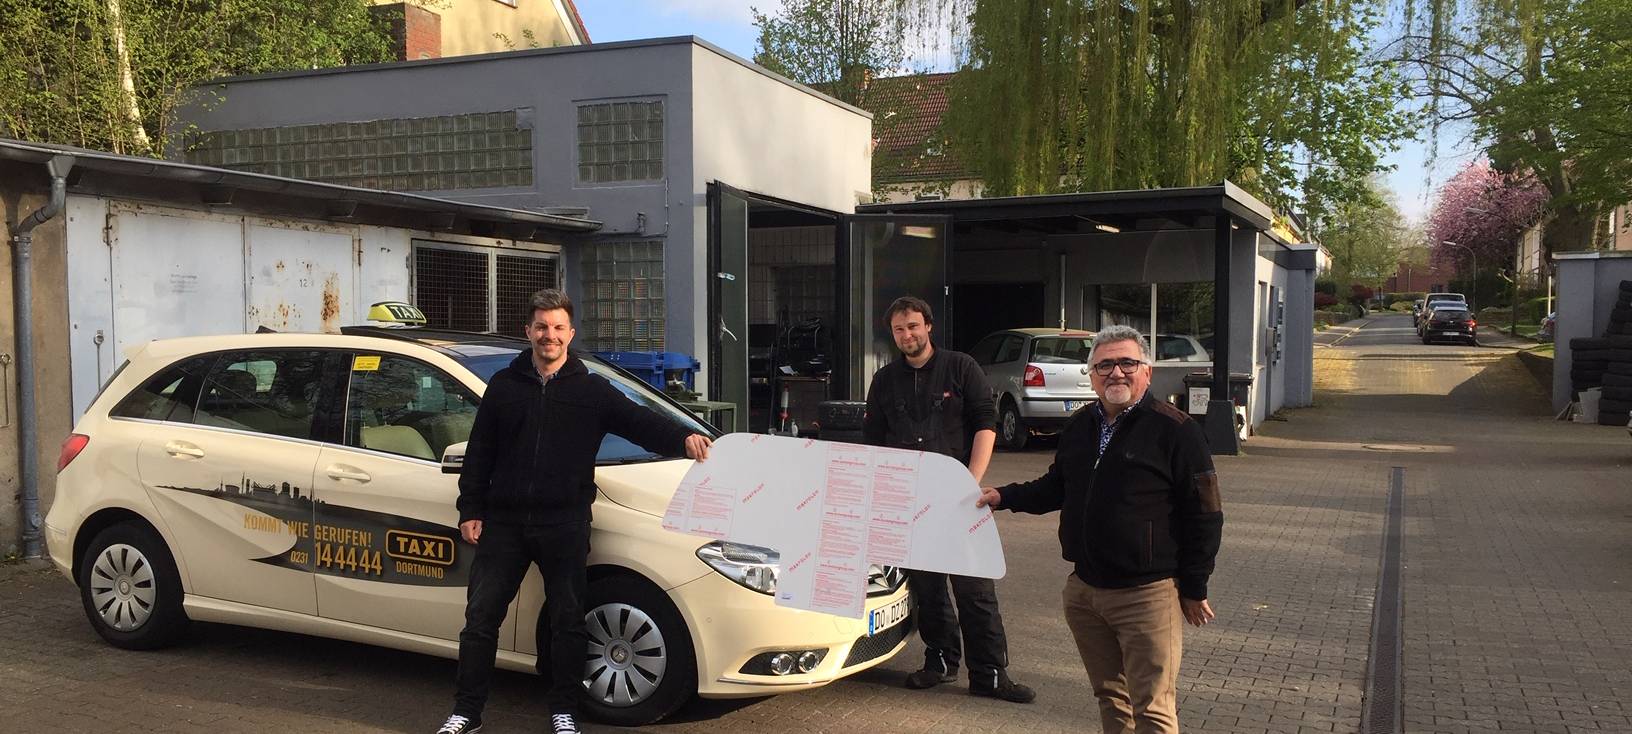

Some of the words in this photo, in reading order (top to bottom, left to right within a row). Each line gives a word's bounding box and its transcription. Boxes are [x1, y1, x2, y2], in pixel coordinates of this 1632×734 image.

[389, 305, 423, 319] TAXI
[244, 513, 282, 535] KOMMT
[287, 520, 309, 538] WIE
[314, 523, 372, 548] GERUFEN!
[396, 536, 444, 559] TAXI
[290, 550, 308, 565] 0231
[314, 542, 382, 576] 144444
[396, 560, 444, 580] DORTMUND
[875, 609, 886, 630] DO
